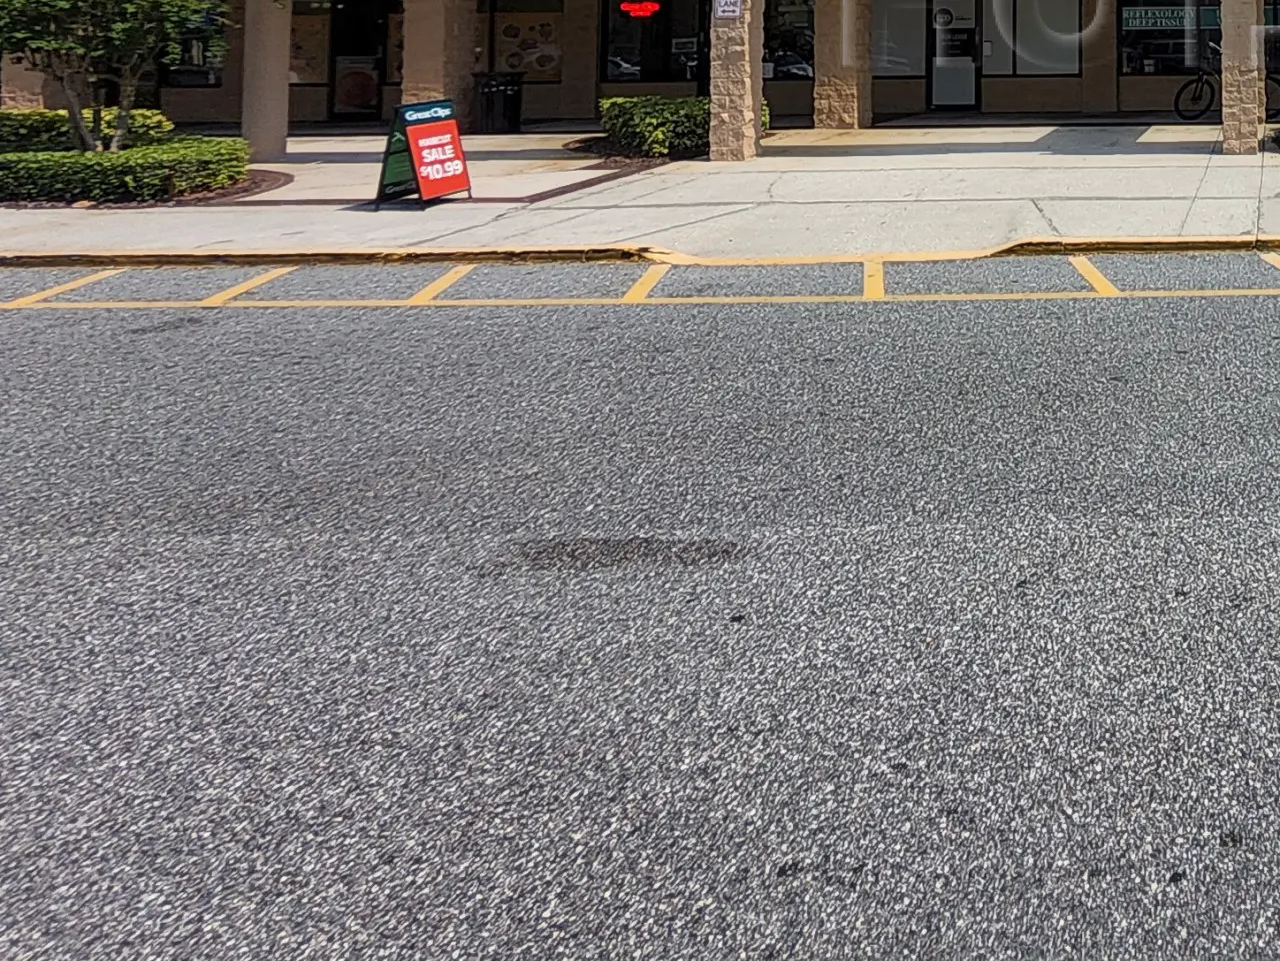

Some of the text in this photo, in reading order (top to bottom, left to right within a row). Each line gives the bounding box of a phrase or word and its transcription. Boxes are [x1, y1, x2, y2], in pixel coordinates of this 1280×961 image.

[718, 0, 739, 8] LANE
[1123, 9, 1195, 18] REFLEXOLOGY
[1128, 18, 1154, 27] DEEP
[422, 145, 455, 162] SALE
[420, 160, 463, 180] $10.99
